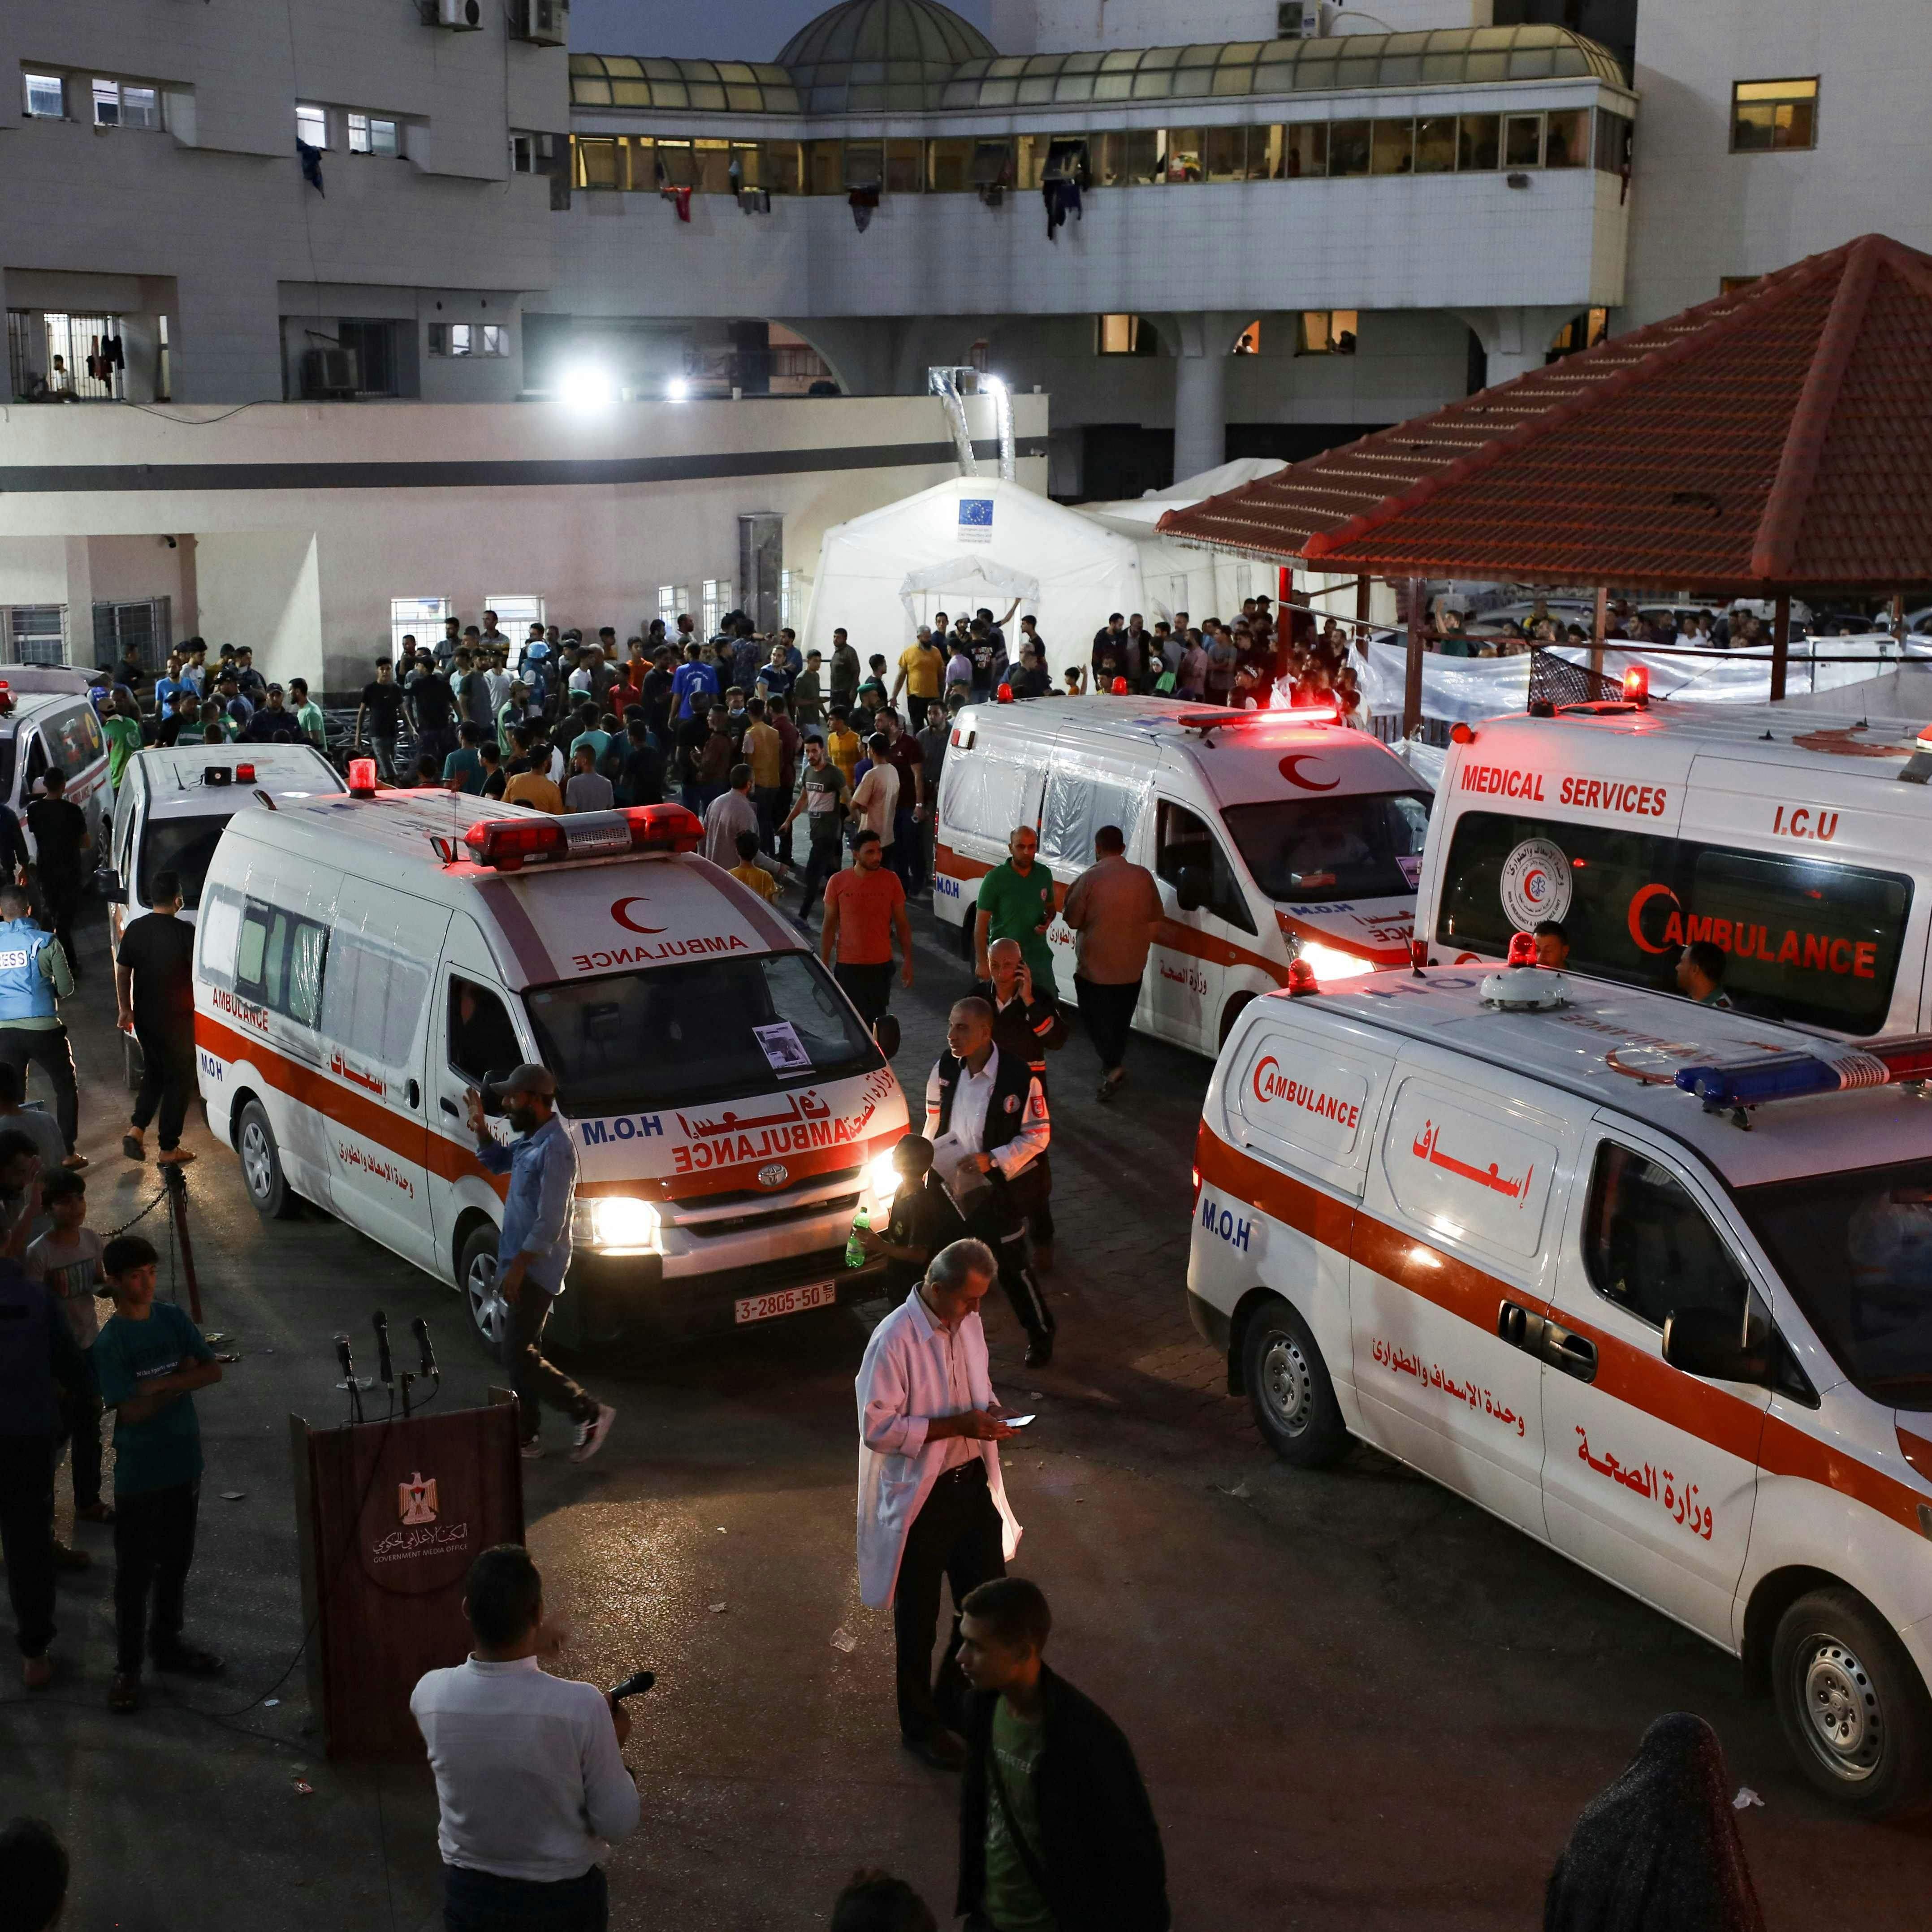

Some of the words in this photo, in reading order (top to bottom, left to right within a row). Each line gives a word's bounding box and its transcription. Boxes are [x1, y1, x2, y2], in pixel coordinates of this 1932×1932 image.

[1461, 765, 1545, 802] MEDICAL
[1560, 777, 1667, 816] SERVICES
[1773, 806, 1839, 841] I.C.U
[937, 876, 959, 899] M.O.H
[1289, 903, 1355, 916] M.O.H
[1510, 903, 1529, 925] EMERGENCY
[1662, 911, 1877, 979] AMBULANCE
[1159, 960, 1188, 983] الصحة
[1189, 968, 1207, 995] وزارة
[213, 988, 268, 1031] AMBULANCE
[1264, 1072, 1359, 1128] AMBULANCE
[581, 1115, 664, 1145] M.O.H
[394, 1167, 414, 1199] وحدة
[1412, 1119, 1534, 1209] إسعاف
[1202, 1198, 1251, 1252] M.O.H
[741, 1287, 820, 1319] 3-2805-50
[1372, 1337, 1428, 1387] والطوارئ
[1430, 1363, 1481, 1409] الإسعاف
[1485, 1390, 1525, 1437] وحدة
[1575, 1425, 1658, 1502] الصحة
[1663, 1469, 1712, 1540] وزارة
[373, 1551, 421, 1563] GOVERNMENT
[446, 1543, 468, 1552] OFFICE
